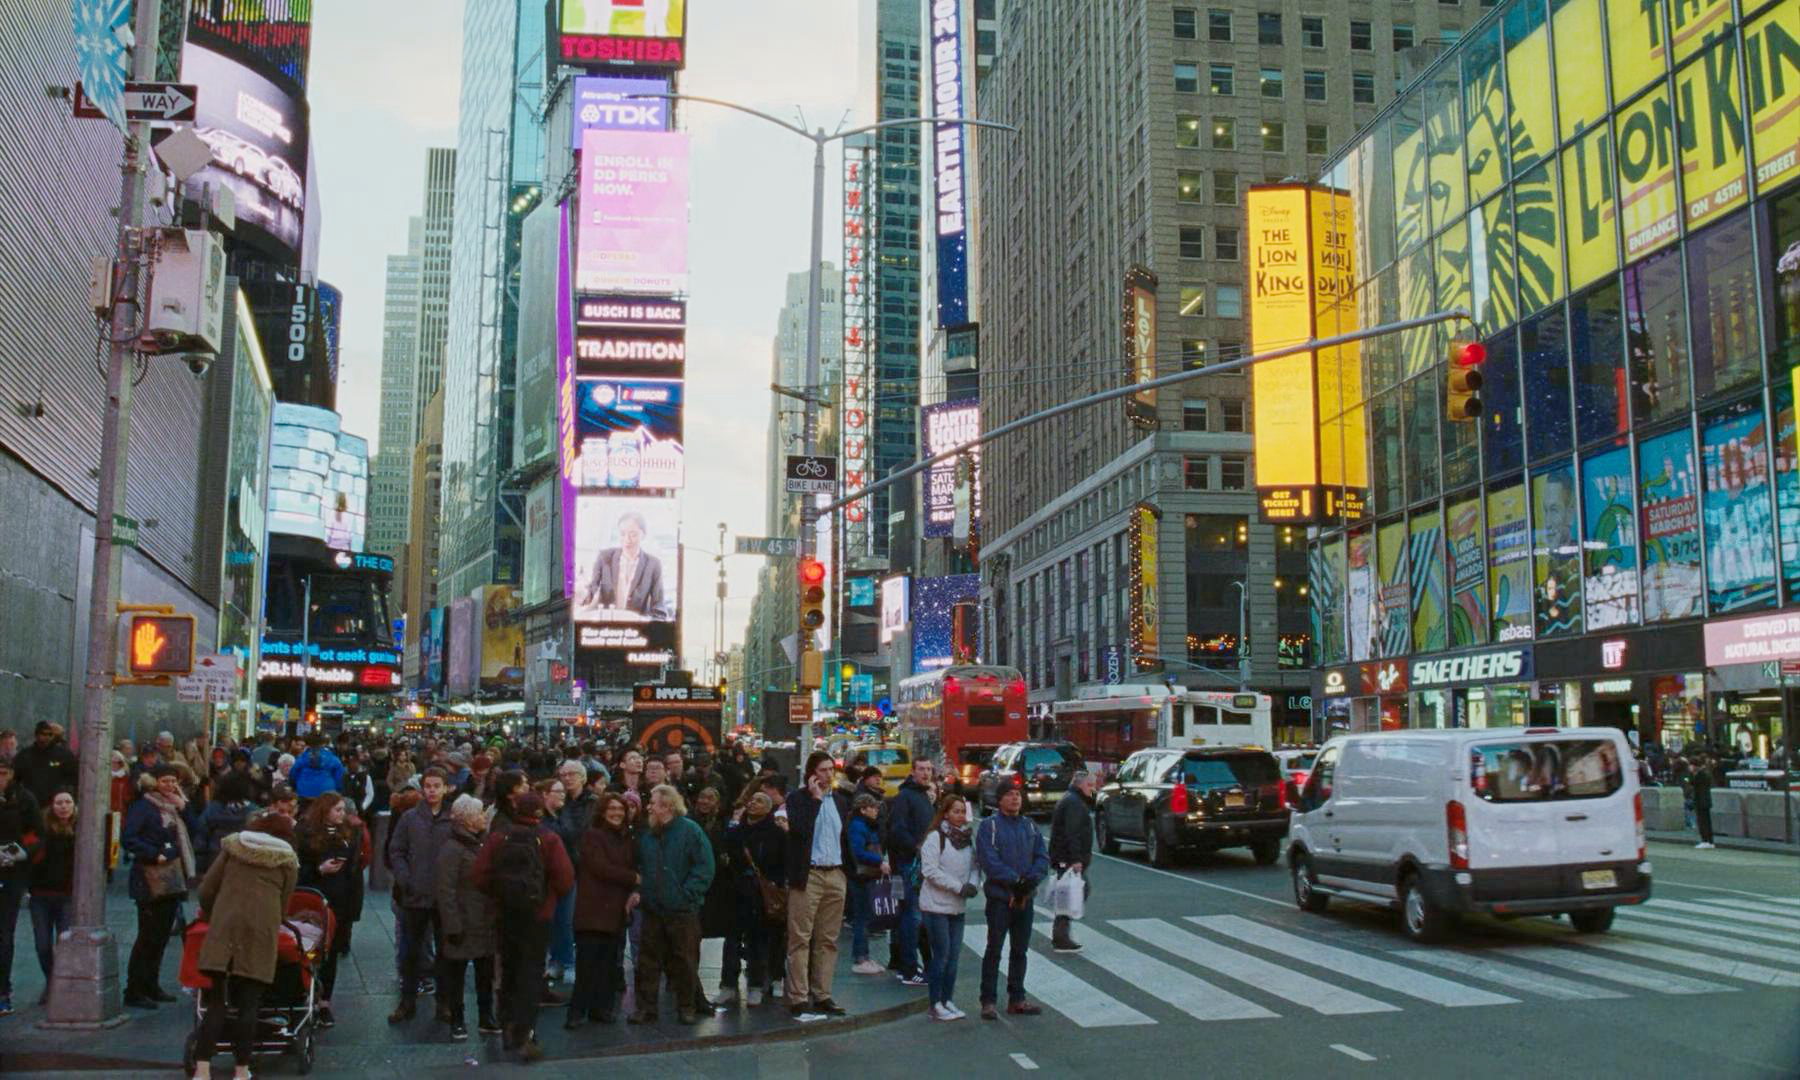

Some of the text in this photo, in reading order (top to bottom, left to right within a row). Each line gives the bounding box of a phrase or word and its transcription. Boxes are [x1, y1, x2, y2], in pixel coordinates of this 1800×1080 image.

[562, 36, 682, 61] TOSHIBA
[934, 37, 960, 126] HOUR
[142, 95, 180, 109] WAY
[599, 105, 660, 125] TDK
[594, 155, 672, 169] ENROLL IN
[1574, 78, 1697, 245] LION
[594, 169, 668, 183] DD PERKS
[937, 128, 964, 235] EARTH
[593, 183, 634, 195] NOW.
[1629, 150, 1796, 252] ENTRANCE ON 45TH STREET
[1262, 229, 1290, 242] THE
[1258, 246, 1297, 268] LION
[1256, 271, 1304, 297] KING
[584, 305, 681, 320] BUSCH IS BACK
[288, 286, 306, 361] 1500
[578, 340, 684, 360] TRADITION
[930, 409, 979, 428] EARTH
[931, 425, 979, 446] HOUR
[789, 480, 833, 491] BIKE LANE
[1272, 490, 1291, 499] GET
[1264, 500, 1299, 508] TICKETS
[1649, 501, 1695, 519] SATURDAY
[1649, 515, 1685, 534] MARCH
[768, 541, 782, 554] 45
[1743, 620, 1786, 638] DERIVED
[1724, 642, 1771, 659] NATURAL
[1412, 651, 1522, 685] SKECHERS
[656, 687, 688, 699] NYC
[874, 897, 898, 916] GAP
